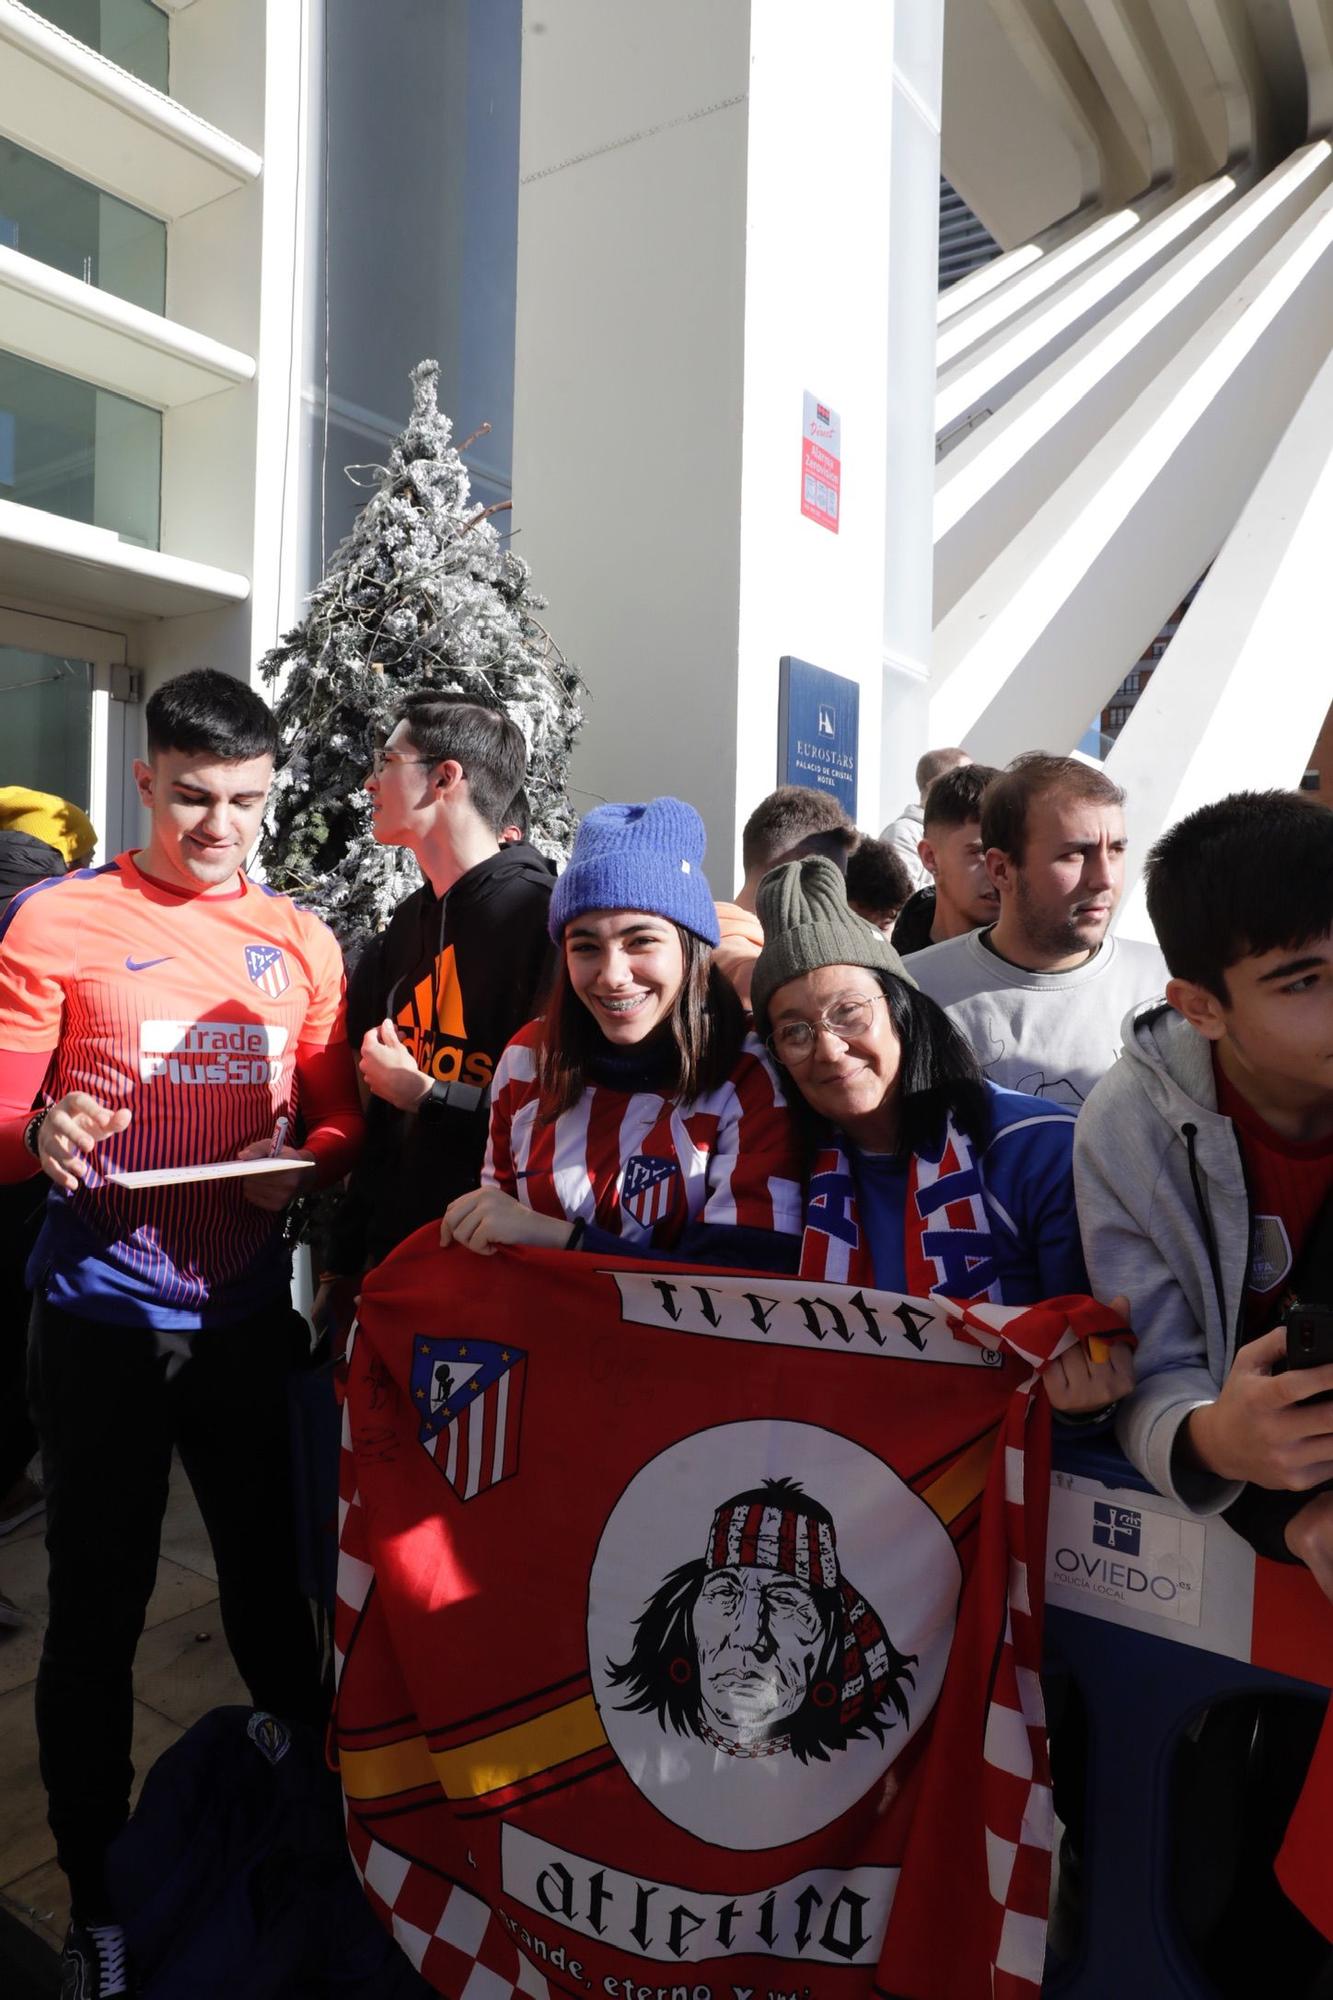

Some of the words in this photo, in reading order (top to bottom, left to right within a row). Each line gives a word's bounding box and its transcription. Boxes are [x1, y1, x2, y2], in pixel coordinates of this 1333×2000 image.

[797, 740, 854, 769] EUROSTARS
[796, 760, 821, 773] PALACIO
[822, 767, 830, 775] DE
[831, 769, 853, 782] CRISTAL
[817, 775, 835, 786] HOTEL
[178, 1025, 263, 1052] Trade
[140, 1056, 283, 1085] Plus500
[401, 1026, 493, 1089] didas
[1093, 1584, 1126, 1601] LOCAL
